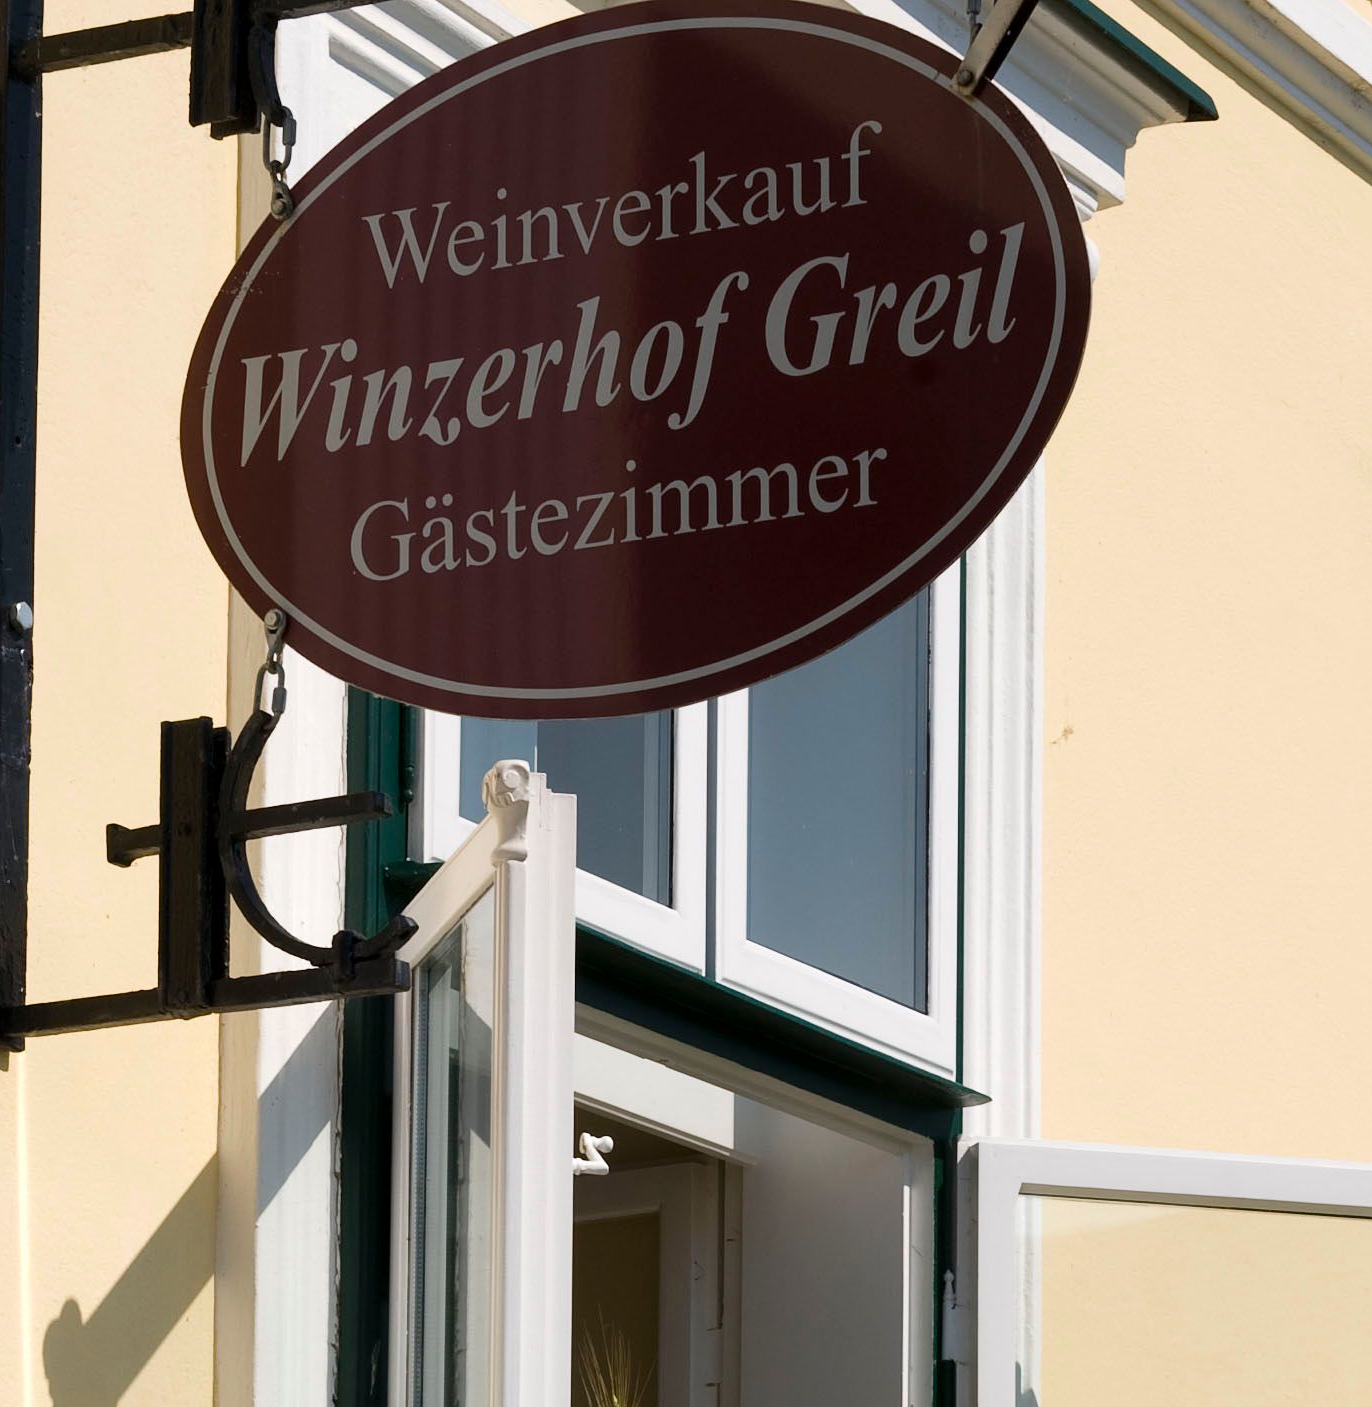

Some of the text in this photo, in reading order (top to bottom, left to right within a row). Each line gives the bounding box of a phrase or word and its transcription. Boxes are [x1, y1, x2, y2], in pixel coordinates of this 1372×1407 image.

[362, 119, 883, 290] Weinverkauf
[239, 222, 1026, 470] Winzerhof Greil
[350, 447, 888, 583] Gästezimmer
